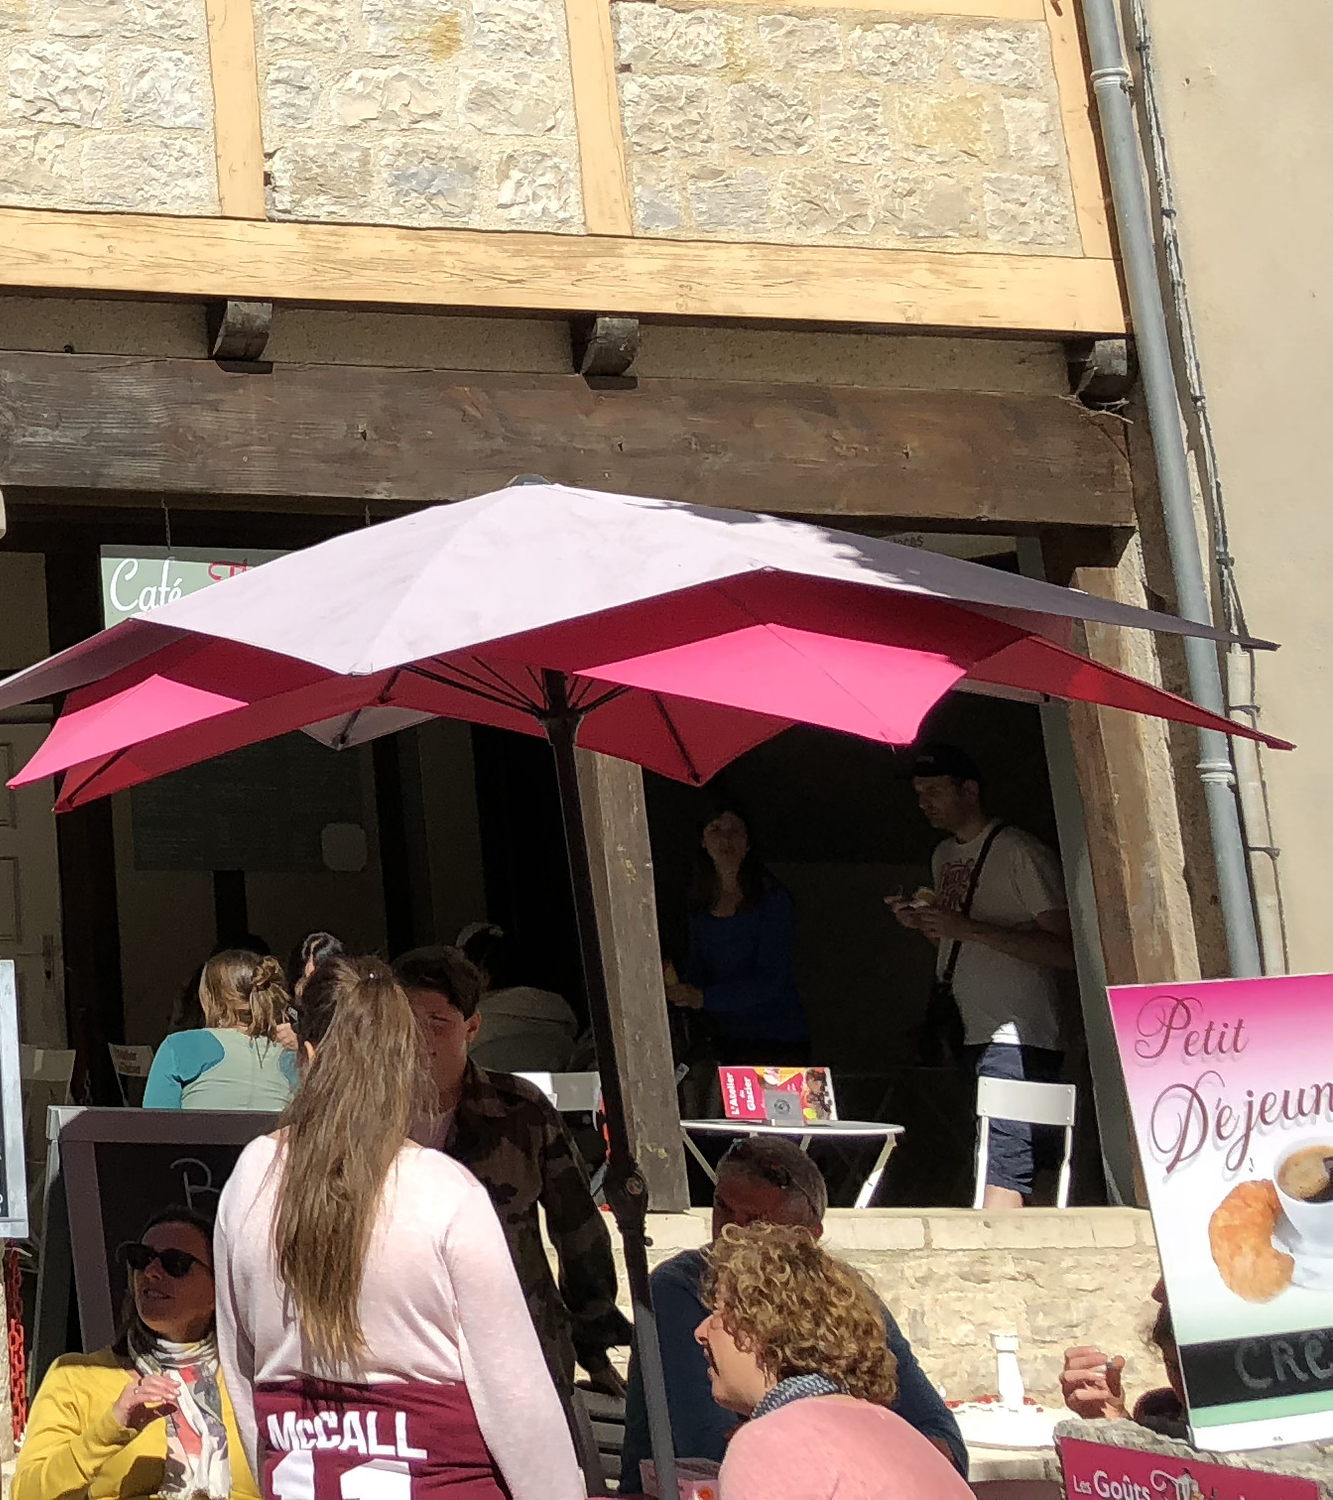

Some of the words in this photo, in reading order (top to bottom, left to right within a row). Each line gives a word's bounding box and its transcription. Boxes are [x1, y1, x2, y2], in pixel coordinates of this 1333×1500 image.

[109, 556, 183, 612] Café
[1134, 995, 1250, 1059] Petit
[743, 1076, 757, 1112] Glacier
[1073, 1474, 1092, 1495] Les
[1093, 1470, 1151, 1500] Goûts
